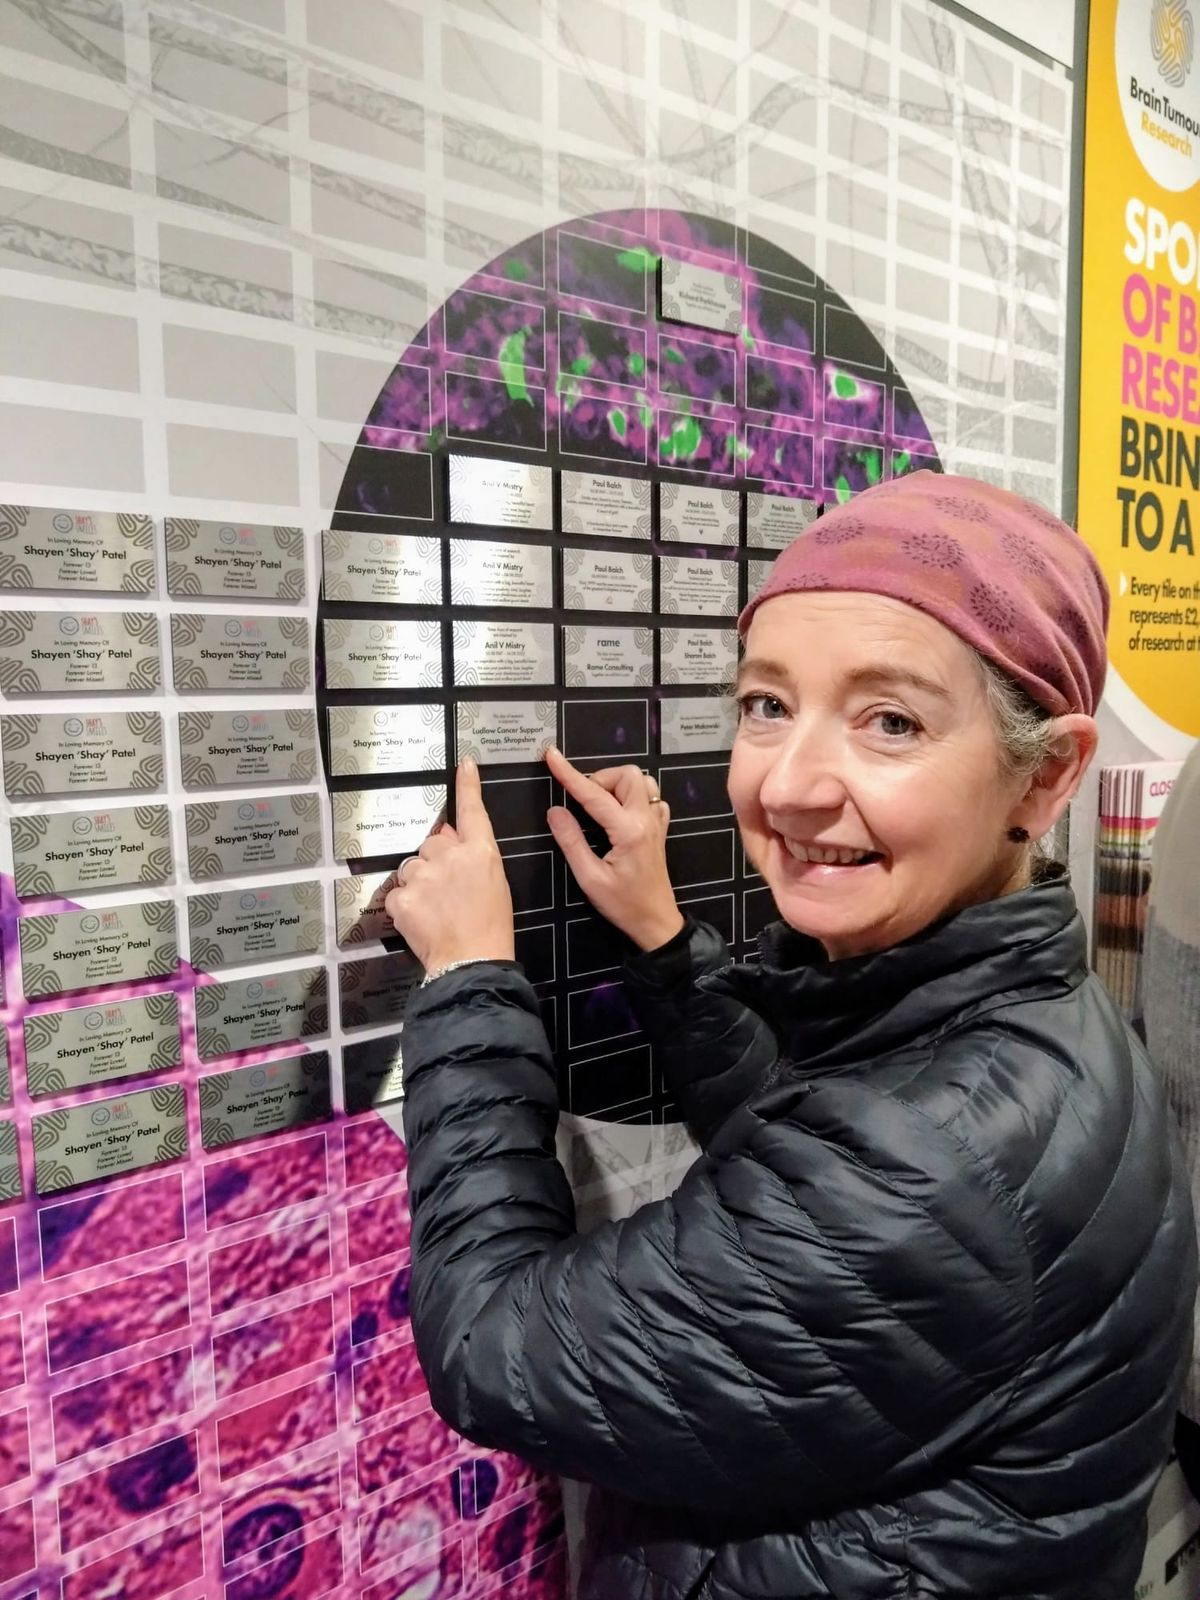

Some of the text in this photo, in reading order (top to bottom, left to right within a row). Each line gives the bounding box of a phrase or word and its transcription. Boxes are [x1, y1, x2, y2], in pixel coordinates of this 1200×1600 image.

[1131, 76, 1200, 138] Brain Tumou
[1141, 111, 1192, 159] Research
[1124, 197, 1200, 290] SPO
[1123, 273, 1200, 355] OF B
[1122, 342, 1200, 425] RESE
[1120, 415, 1200, 492] BRIN
[503, 482, 523, 492] Mistry
[1117, 486, 1194, 556] TO A
[24, 545, 64, 558] Shayen
[102, 550, 127, 560] Patel
[194, 555, 228, 567] Shayen
[261, 560, 281, 568] Patel
[503, 563, 523, 572] Mistry
[347, 565, 376, 576] Shayen
[1131, 576, 1161, 603] Every
[1178, 586, 1191, 599] on
[1130, 608, 1183, 629] represents
[485, 641, 498, 649] Anil
[506, 641, 526, 650] Mistry
[1129, 630, 1140, 650] of
[1142, 631, 1185, 650] research
[1186, 636, 1196, 651] at
[31, 650, 71, 661] Shayen
[108, 649, 132, 658] Patel
[200, 649, 234, 660] Shayen
[266, 651, 287, 659] Patel
[348, 653, 377, 663] Shayen
[404, 653, 421, 661] Patel
[604, 664, 634, 672] Consulting
[497, 726, 518, 734] Cancer
[519, 726, 543, 734] Support
[353, 739, 381, 749] Shayen
[504, 736, 536, 744] Shropshire
[35, 752, 74, 763] Shayen
[112, 748, 136, 758] Patel
[208, 746, 241, 756] Shayen
[273, 742, 293, 751] Patel
[1150, 780, 1176, 797] CLOS
[215, 835, 247, 845] Shayen
[279, 827, 299, 837] Patel
[356, 823, 384, 832] Shayen
[45, 850, 84, 862] Shayen
[120, 842, 144, 853] Patel
[216, 925, 249, 935] Shayen
[280, 915, 300, 926] Patel
[53, 949, 91, 960] Shayen
[127, 938, 151, 950] Patel
[223, 1012, 255, 1025] Shayen
[285, 1001, 306, 1012] Patel
[57, 1046, 95, 1059] Shayen
[130, 1032, 154, 1044] Patel
[227, 1101, 259, 1114] Shayen
[64, 1142, 102, 1156] Shayen
[137, 1124, 160, 1137] Patel
